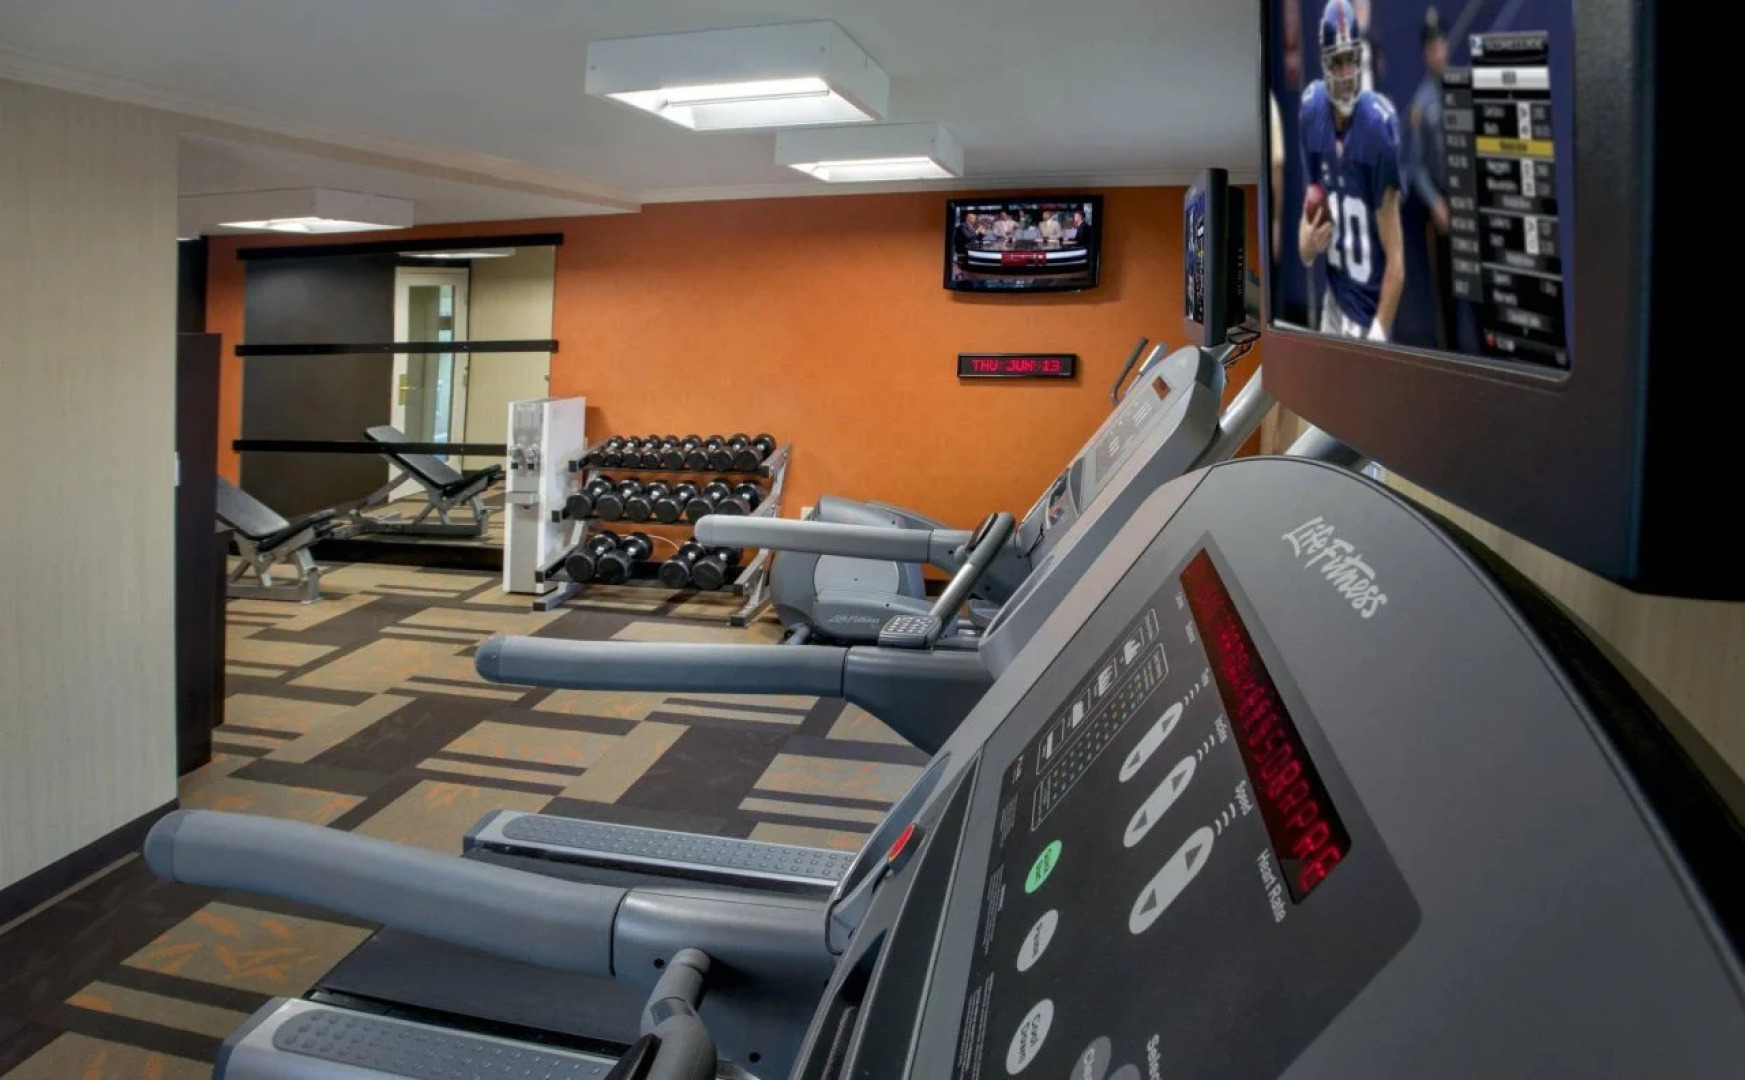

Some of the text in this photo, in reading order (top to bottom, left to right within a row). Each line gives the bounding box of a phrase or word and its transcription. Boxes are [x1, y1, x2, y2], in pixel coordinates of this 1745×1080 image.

[1328, 191, 1372, 283] 10
[972, 359, 1060, 372] THU JUN 13
[1257, 849, 1286, 922] Heart Rate
